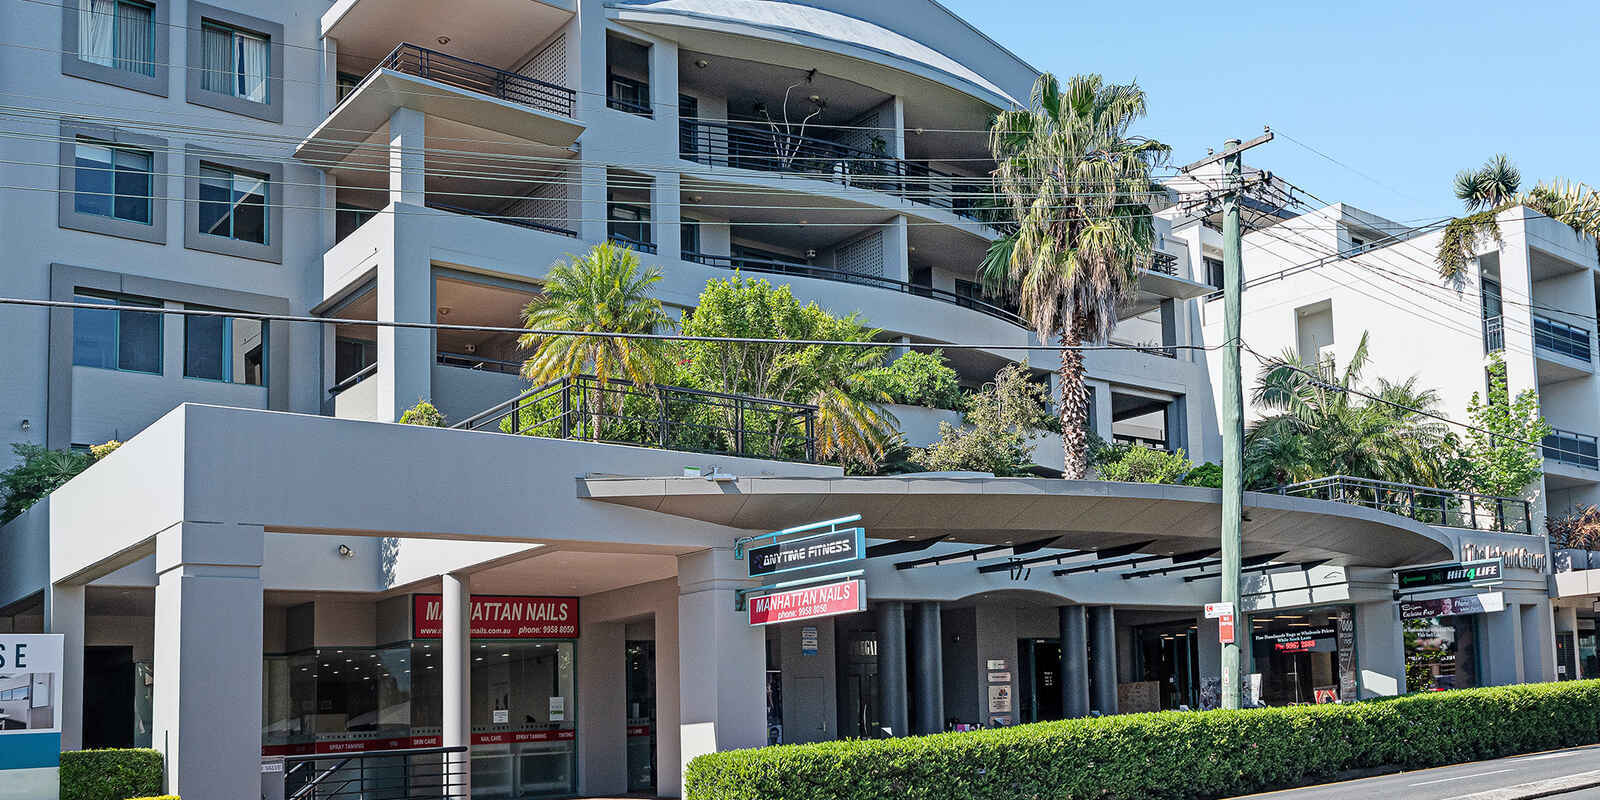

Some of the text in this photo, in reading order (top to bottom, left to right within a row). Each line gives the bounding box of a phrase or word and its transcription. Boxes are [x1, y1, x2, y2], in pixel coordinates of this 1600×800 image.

[763, 547, 805, 566] ANYTIME
[1519, 547, 1546, 573] Group
[756, 584, 850, 613] MANHATTAN NAILS
[425, 602, 568, 621] MATTAN NAILS
[777, 608, 797, 621] phone:
[518, 626, 542, 635] phone:
[329, 743, 345, 751] SPRAY
